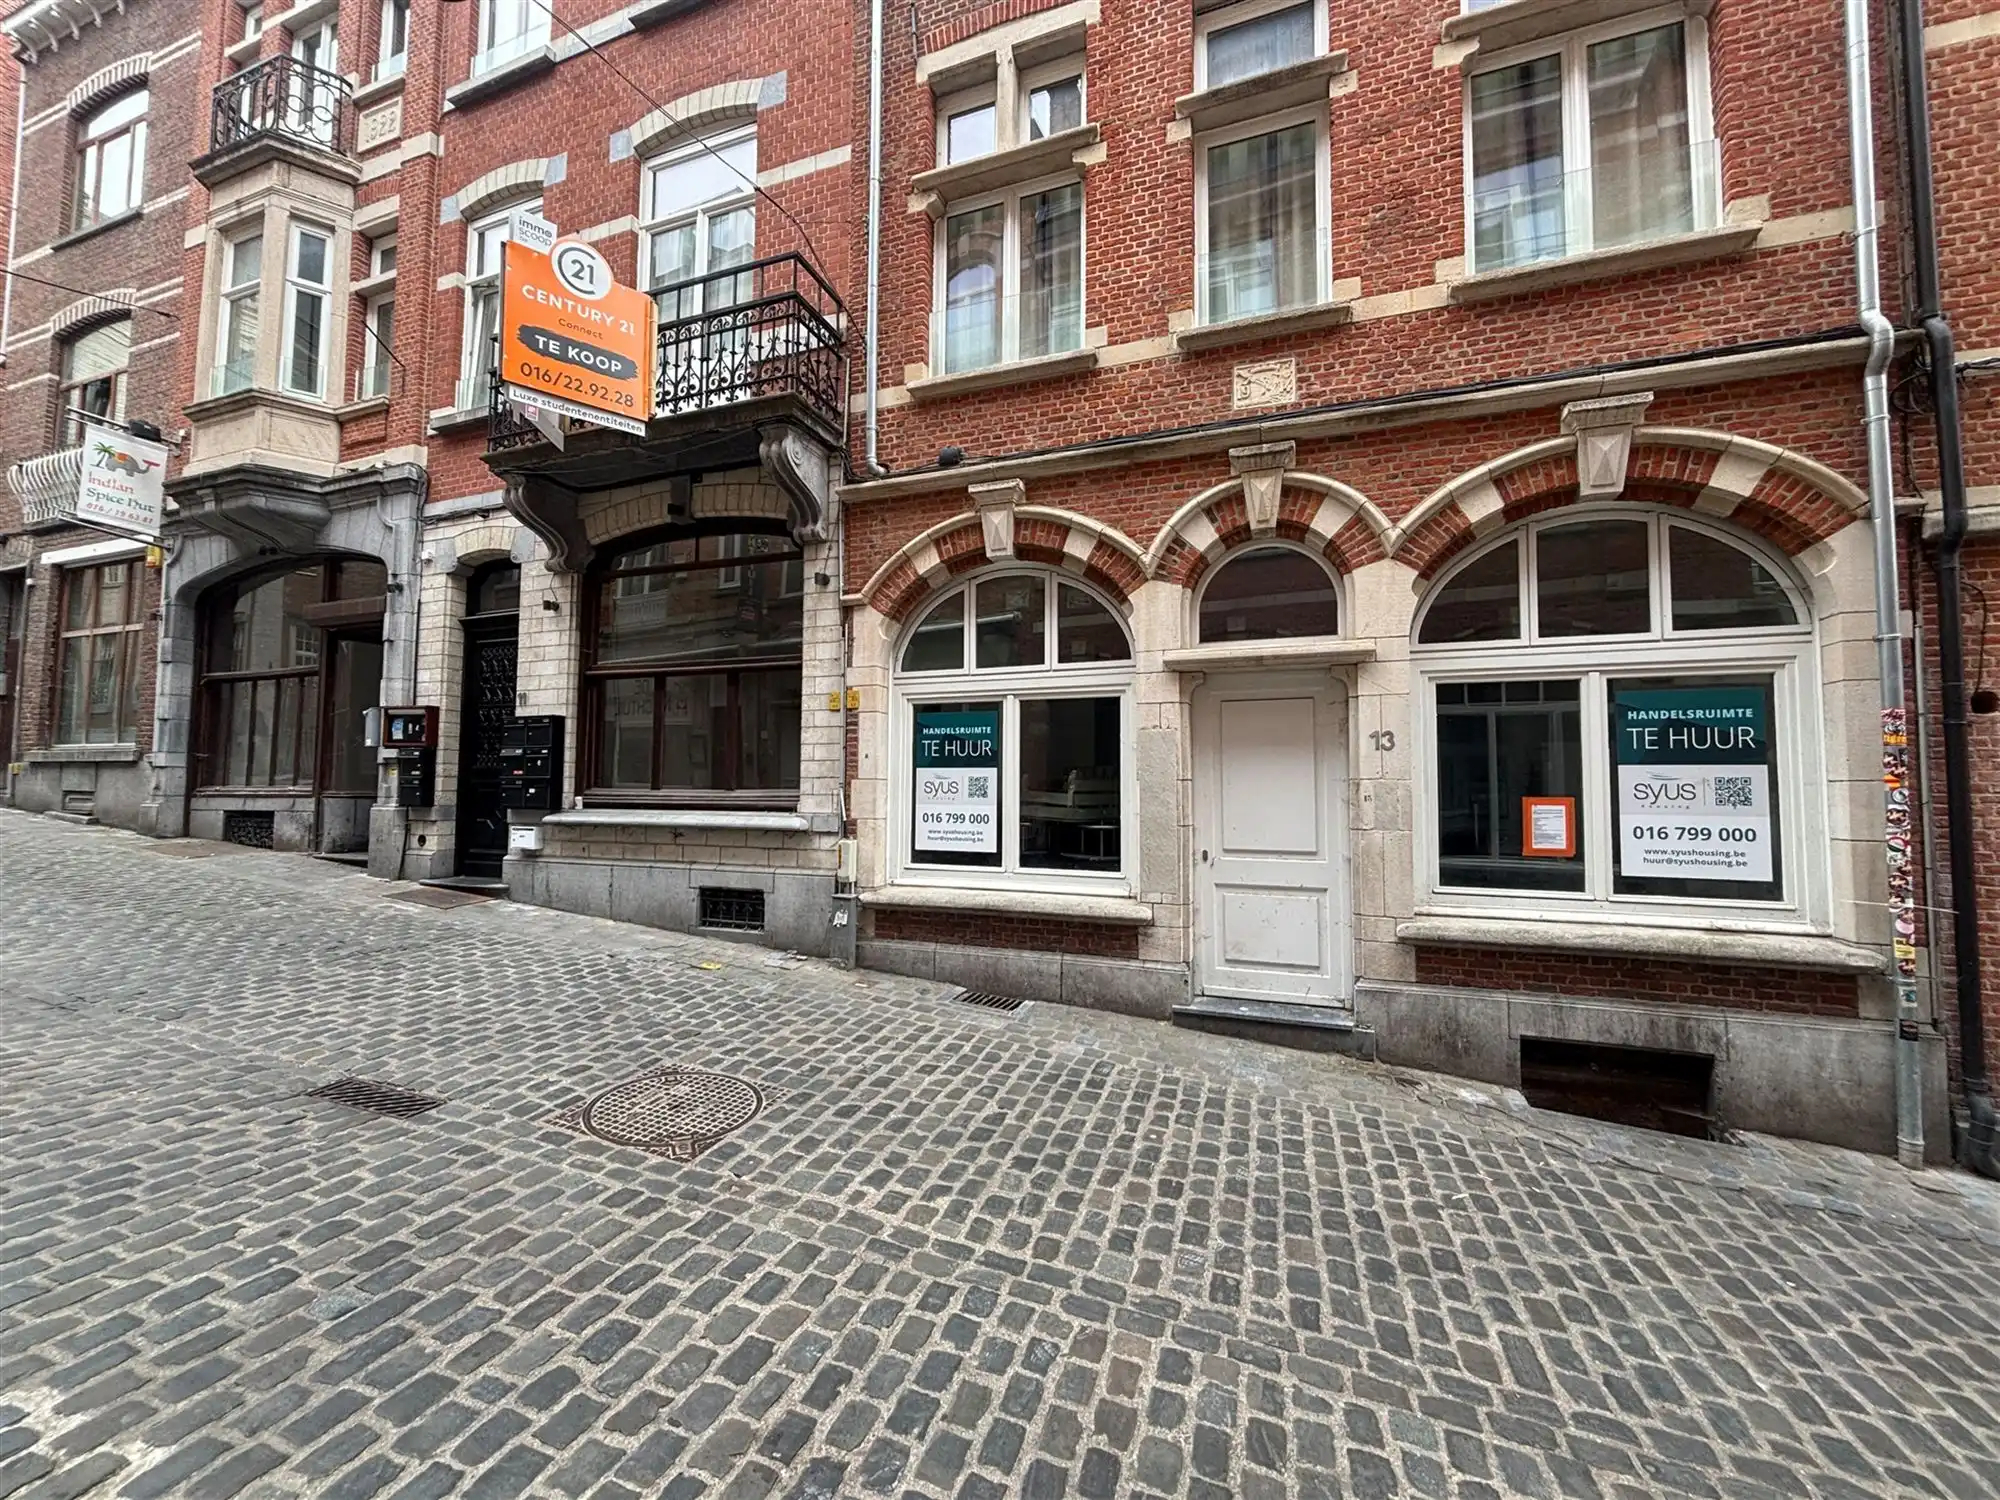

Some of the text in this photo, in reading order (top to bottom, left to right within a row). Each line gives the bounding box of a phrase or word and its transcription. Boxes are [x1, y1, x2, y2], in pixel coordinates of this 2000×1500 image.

[519, 227, 553, 247] scoop
[521, 284, 637, 337] CENTURY 21
[558, 318, 604, 340] Connect
[535, 334, 623, 373] TE KOOP
[520, 362, 635, 408] 016/22.92.28
[513, 389, 539, 404] Luxe
[541, 396, 643, 433] studentenentiteiten
[88, 471, 135, 495] Indian
[86, 487, 124, 507] Spice
[1627, 708, 1754, 720] HANDELSRUIMTE
[922, 726, 992, 735] HANDELSRUIMTE
[1626, 726, 1756, 750] TE HUUR
[921, 739, 992, 757] TE HUUR
[1368, 730, 1396, 752] 13
[922, 812, 990, 825] 016 799 000
[928, 829, 984, 837] www.syushousing.be
[1632, 825, 1757, 842] 016 799 000
[1642, 857, 1748, 869] huur@syushousing.be
[1643, 848, 1747, 859] www.syushousing.be
